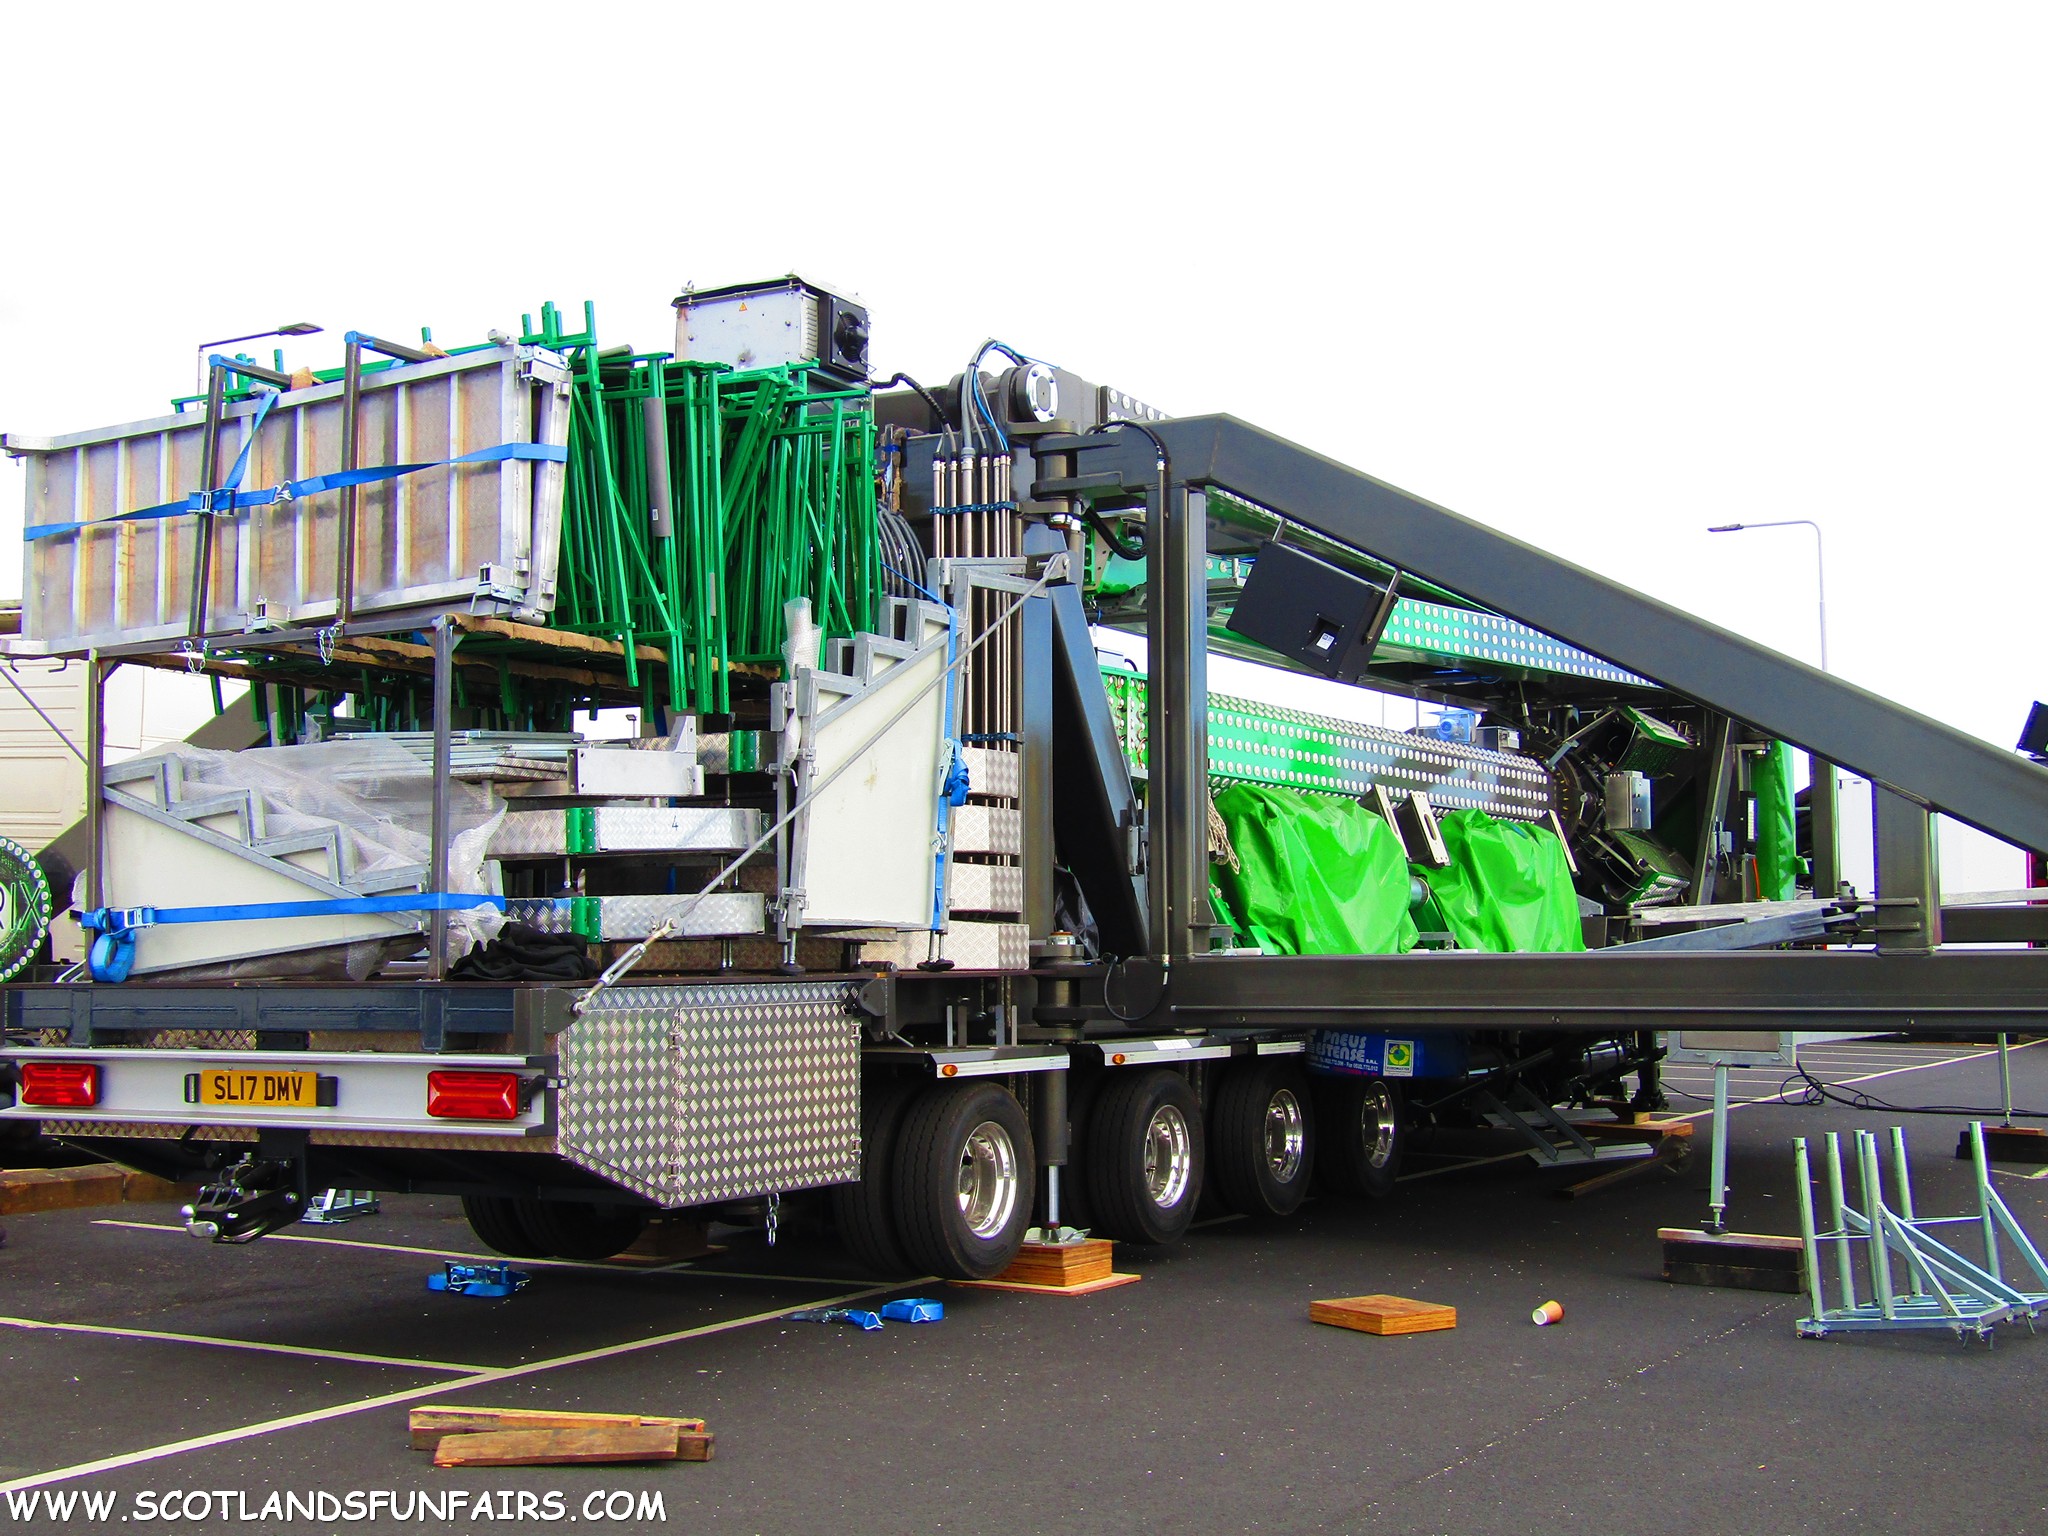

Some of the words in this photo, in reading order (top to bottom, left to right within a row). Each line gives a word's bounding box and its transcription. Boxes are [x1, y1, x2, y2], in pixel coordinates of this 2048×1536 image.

[0, 880, 43, 930] IX
[1323, 1030, 1367, 1049] PNEUS
[1316, 1043, 1366, 1062] ESTENSE
[214, 1075, 257, 1101] SL17
[264, 1076, 303, 1101] DMV
